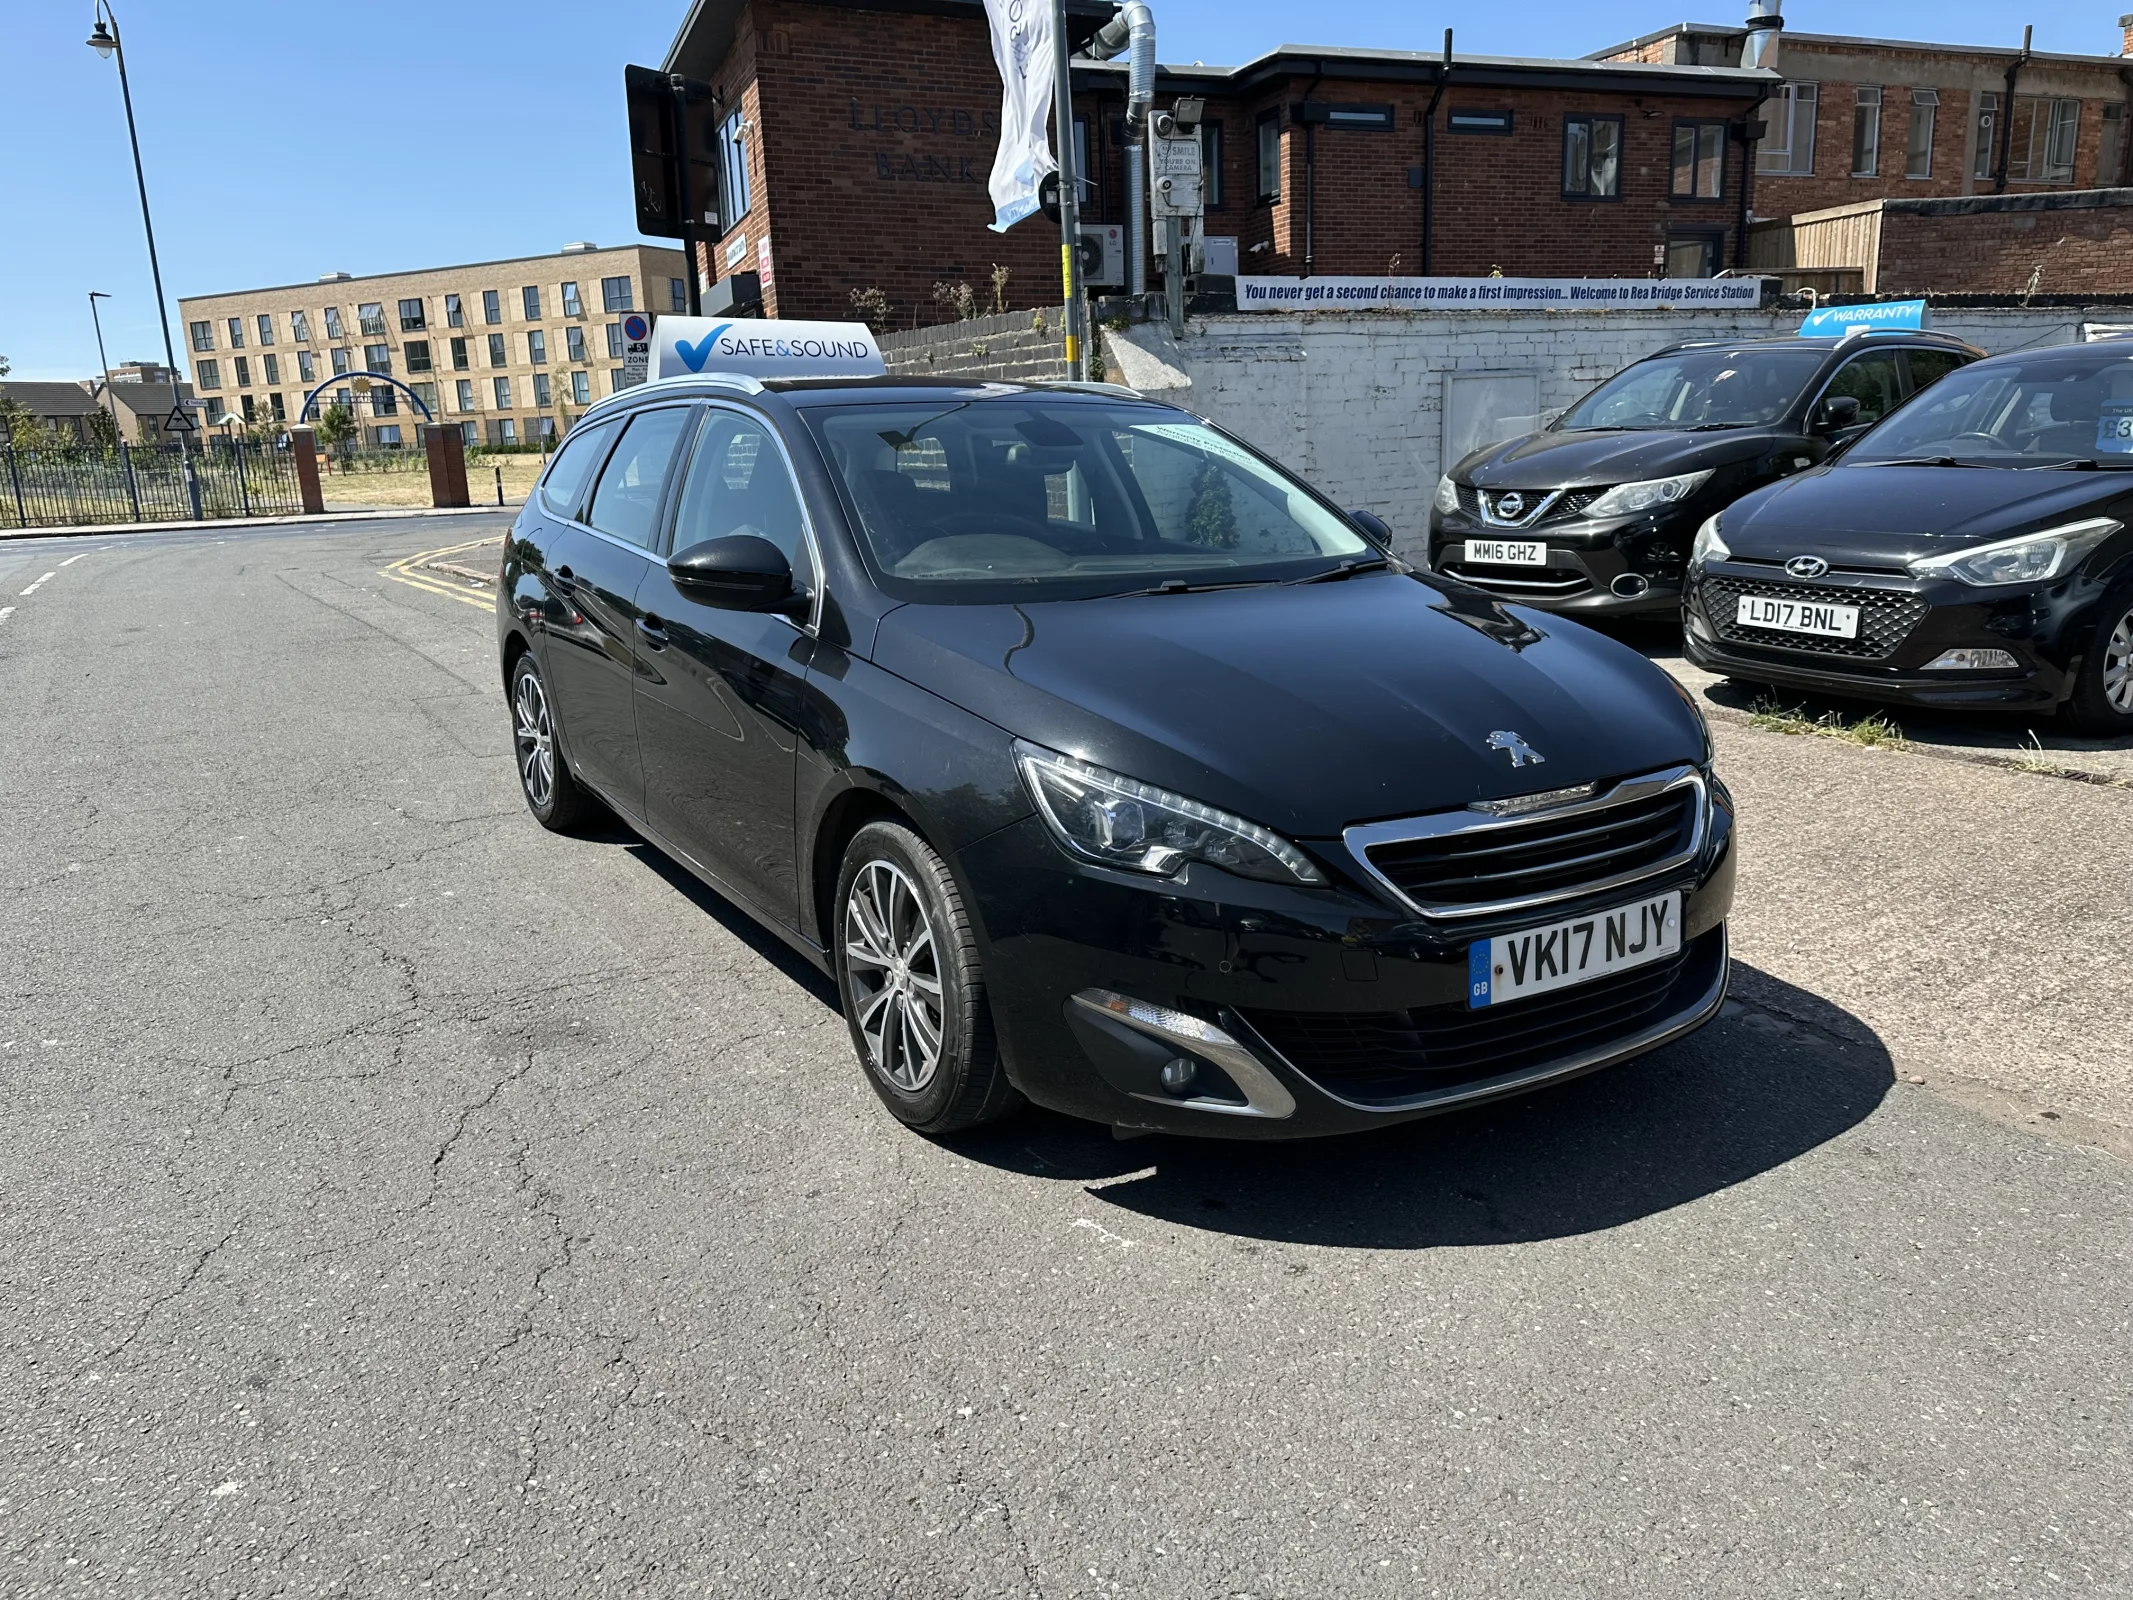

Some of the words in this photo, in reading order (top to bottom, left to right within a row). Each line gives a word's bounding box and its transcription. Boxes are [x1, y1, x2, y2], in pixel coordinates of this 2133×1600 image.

[850, 101, 996, 136] LLOYDS
[1172, 146, 1196, 156] SMILE
[876, 151, 984, 184] BANK
[1245, 284, 1264, 300] You
[1268, 286, 1303, 299] never
[1304, 285, 1324, 301] get
[1326, 287, 1334, 299] a
[1335, 284, 1378, 299] second
[1380, 284, 1422, 299] chance
[1423, 285, 1435, 299] to
[1437, 284, 1468, 299] make
[1469, 286, 1477, 299] a
[1478, 284, 1501, 299] first
[1503, 285, 1568, 301] impression...
[1571, 285, 1617, 300] Welcome
[1618, 286, 1629, 299] to
[1630, 285, 1648, 299] Rea
[1651, 285, 1682, 301] Bridge
[1684, 285, 1720, 299] Service
[1721, 285, 1754, 299] Station
[1833, 305, 1917, 322] WARRANTY
[720, 337, 868, 359] SAFE&SOUND
[627, 356, 649, 364] ZONE
[1474, 542, 1503, 560] MM16
[1508, 545, 1537, 561] GHZ
[1750, 600, 1794, 625] LD17
[1800, 606, 1842, 631] BNL
[1507, 920, 1594, 987] VK17
[1605, 899, 1669, 963] NJY
[1473, 981, 1488, 996] GB
